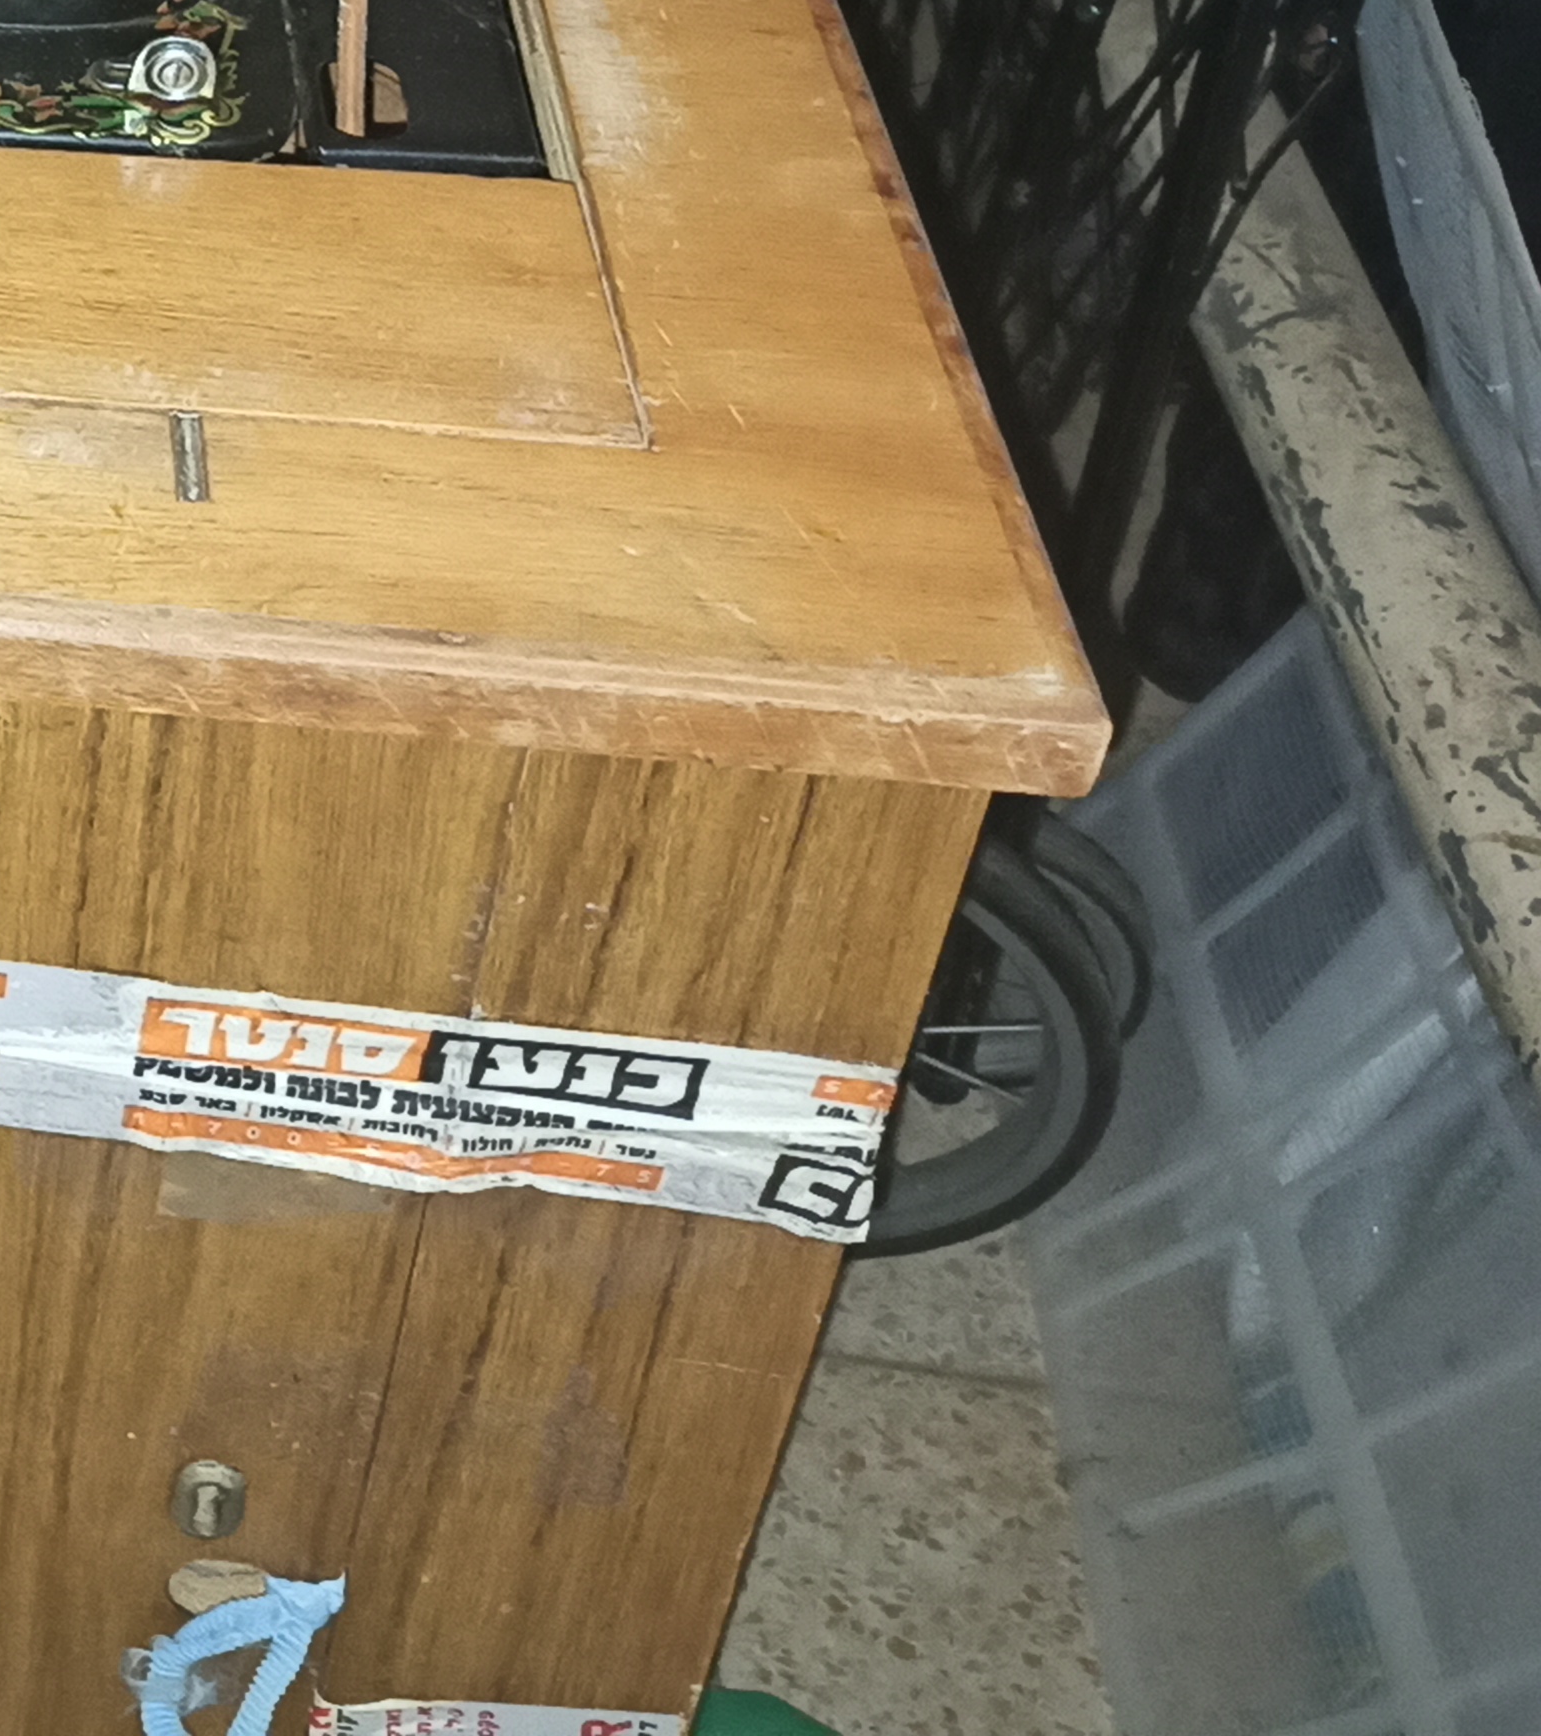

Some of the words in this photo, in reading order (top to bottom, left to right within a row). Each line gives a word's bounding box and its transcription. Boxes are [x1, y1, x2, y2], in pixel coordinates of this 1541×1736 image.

[158, 1007, 417, 1077] סנטר
[440, 1039, 695, 1107] כנען
[194, 1095, 237, 1112] באר
[258, 1104, 342, 1126] אשקלון
[361, 1117, 439, 1143] רחובות
[461, 1135, 514, 1153] חולון
[615, 1143, 657, 1160] נשר
